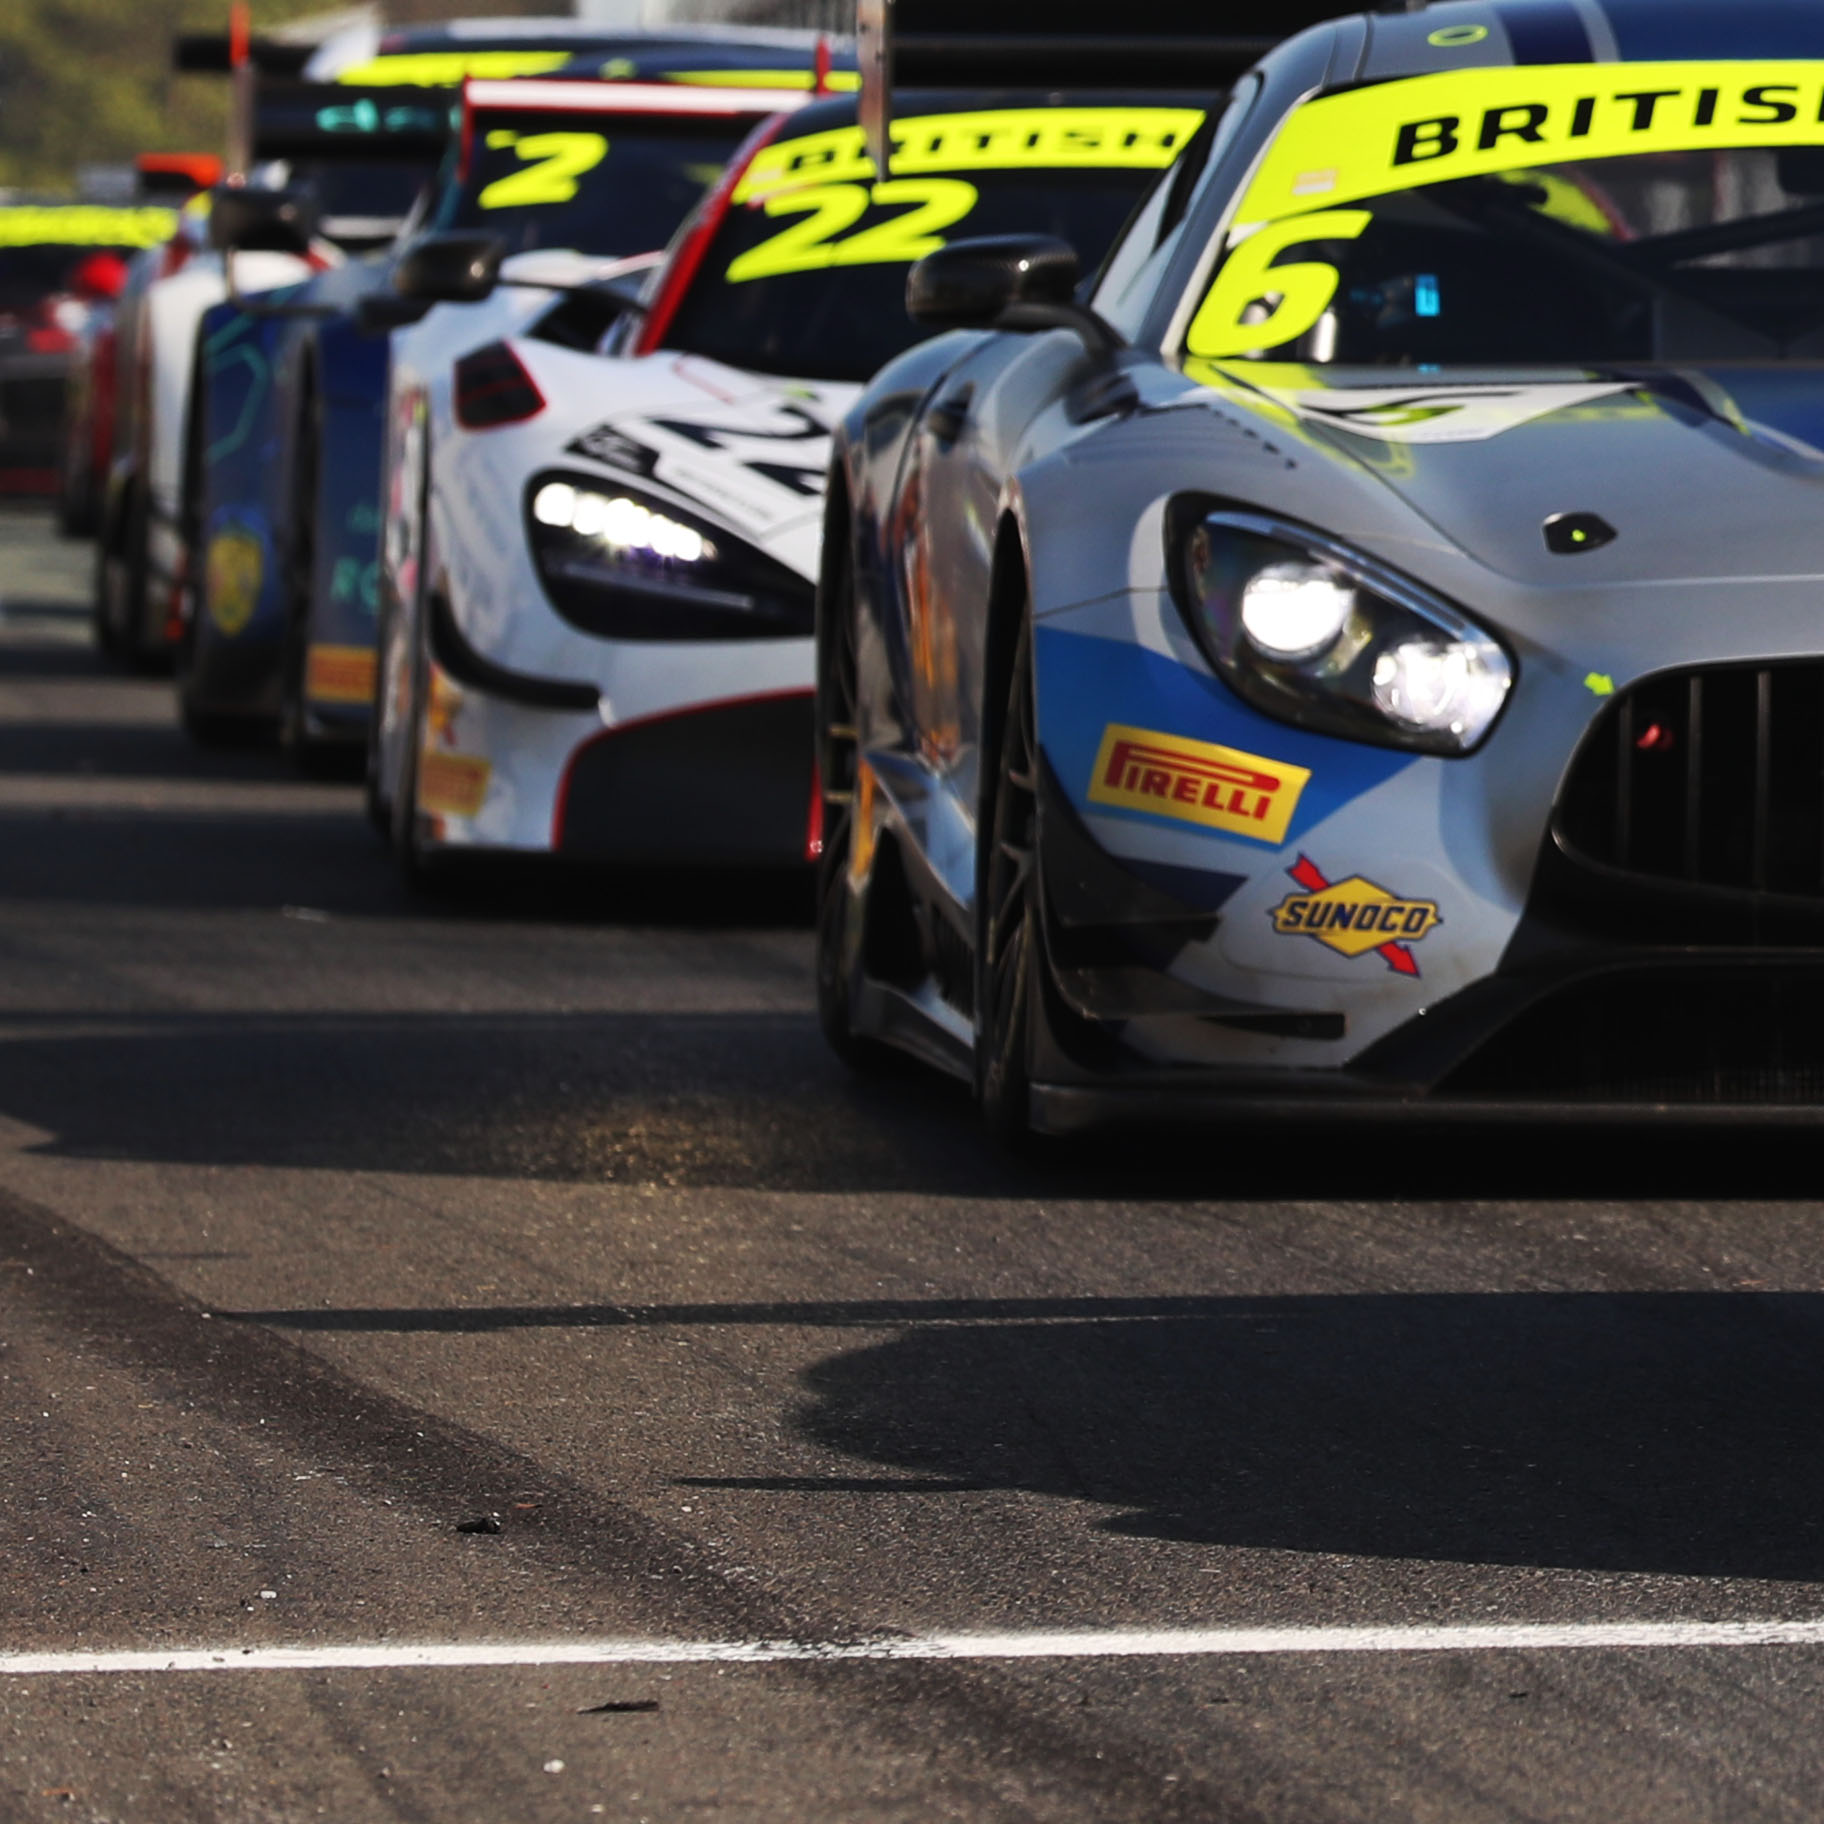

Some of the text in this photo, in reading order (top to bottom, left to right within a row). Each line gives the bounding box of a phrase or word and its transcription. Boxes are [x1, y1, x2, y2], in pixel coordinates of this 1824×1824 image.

[725, 177, 979, 283] 22
[1187, 209, 1373, 357] 6
[1104, 738, 1283, 821] PIRELLI
[1281, 897, 1431, 939] SUNOCO
